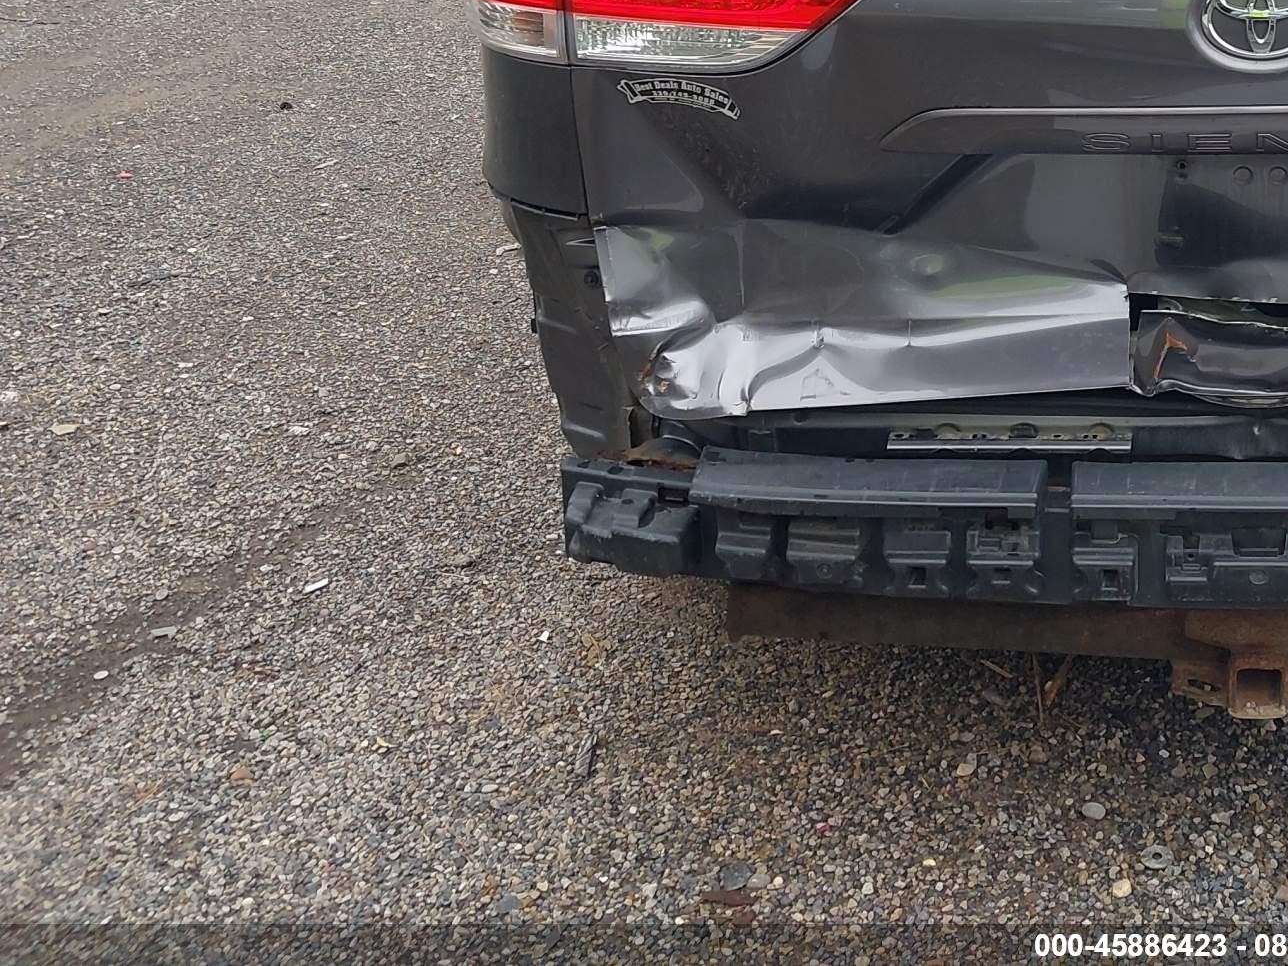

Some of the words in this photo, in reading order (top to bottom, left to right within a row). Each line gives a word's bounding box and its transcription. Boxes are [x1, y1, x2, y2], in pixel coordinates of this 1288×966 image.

[634, 82, 654, 93] Best
[654, 81, 679, 90] Deals
[681, 81, 702, 94] Auto
[704, 87, 729, 104] Sales
